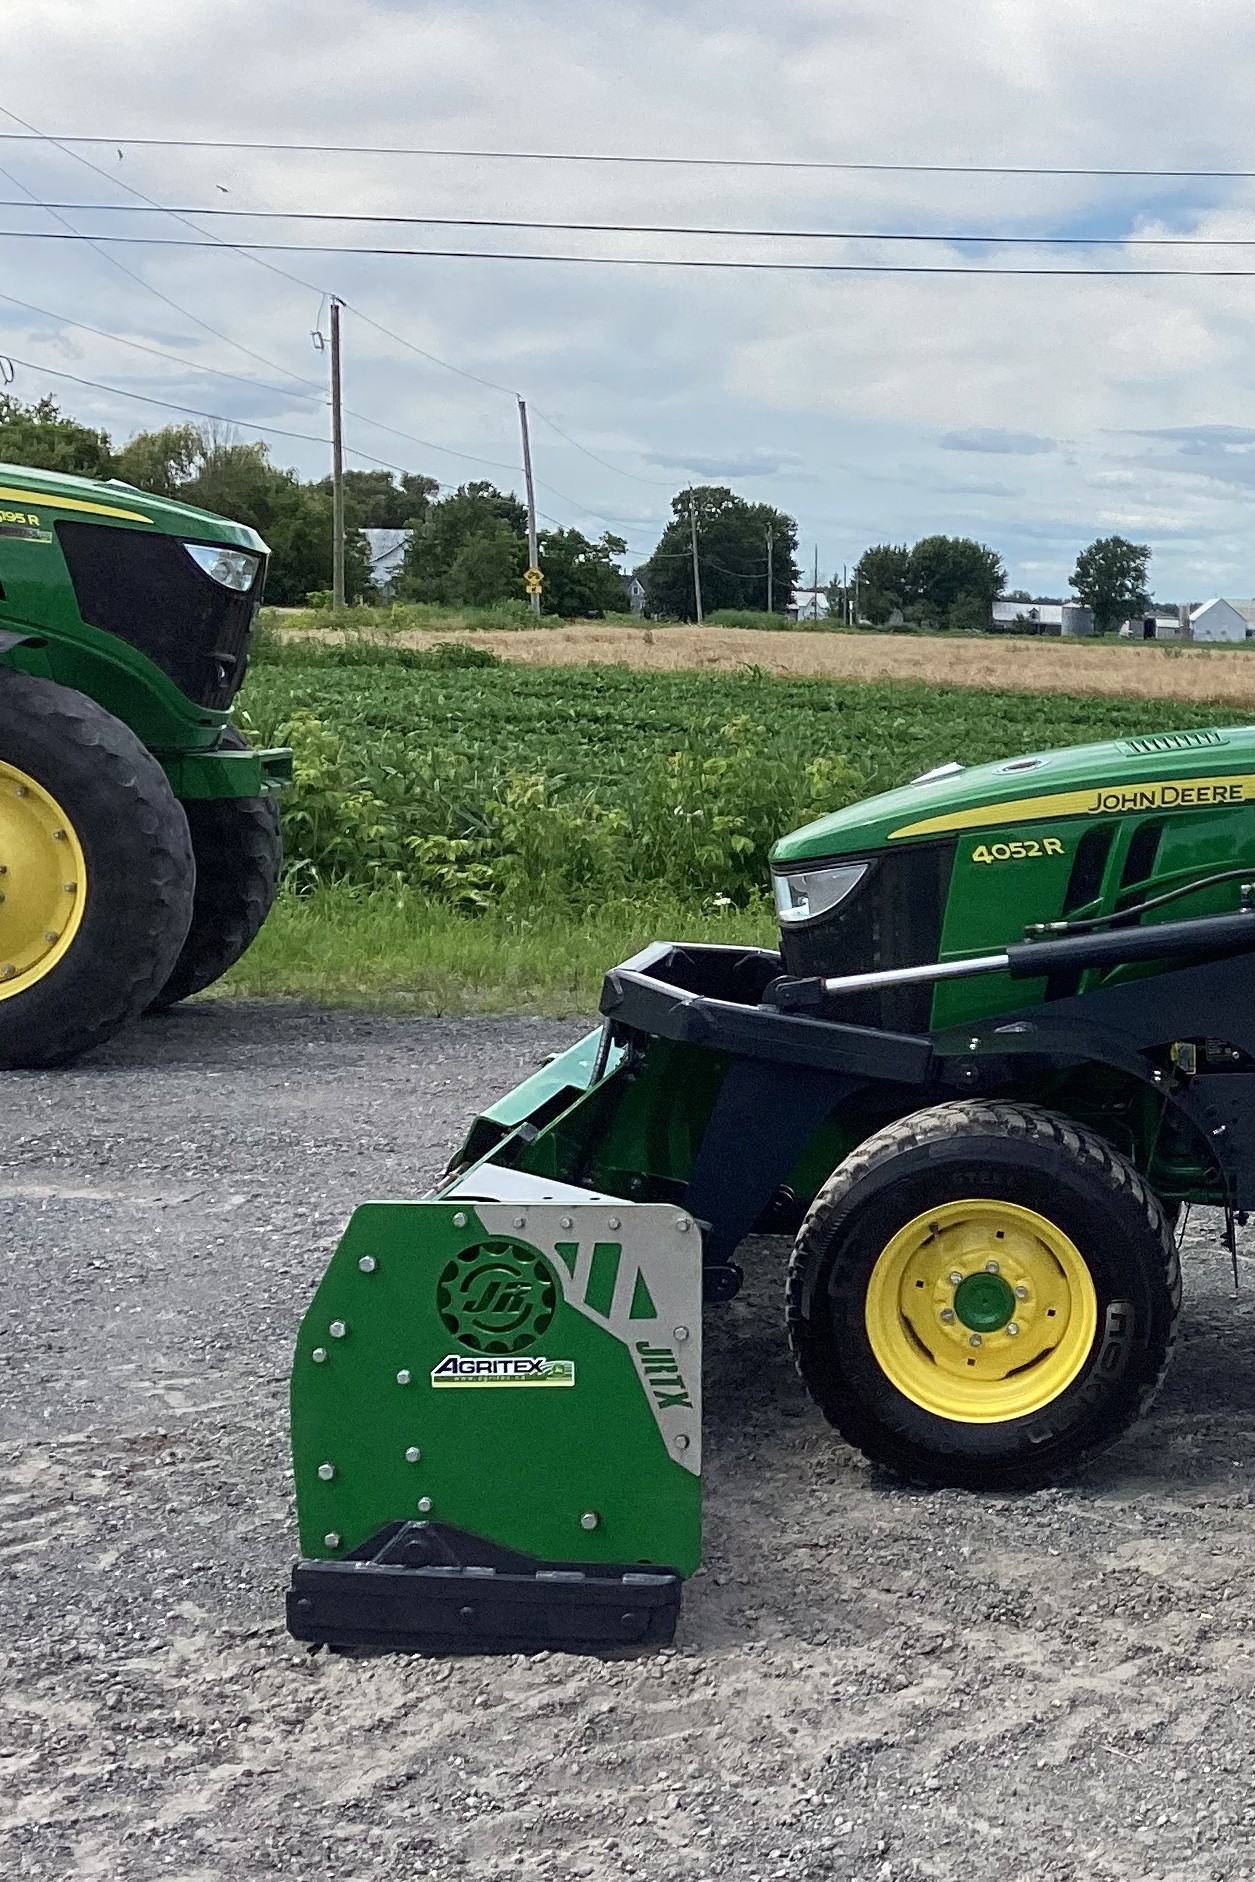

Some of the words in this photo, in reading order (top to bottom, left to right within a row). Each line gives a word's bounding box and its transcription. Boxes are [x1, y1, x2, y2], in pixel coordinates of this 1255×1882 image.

[1088, 786, 1157, 814] JOHN
[1160, 783, 1244, 807] DEERE
[434, 1357, 544, 1374] AGRITEX
[635, 1341, 694, 1410] JRTX
